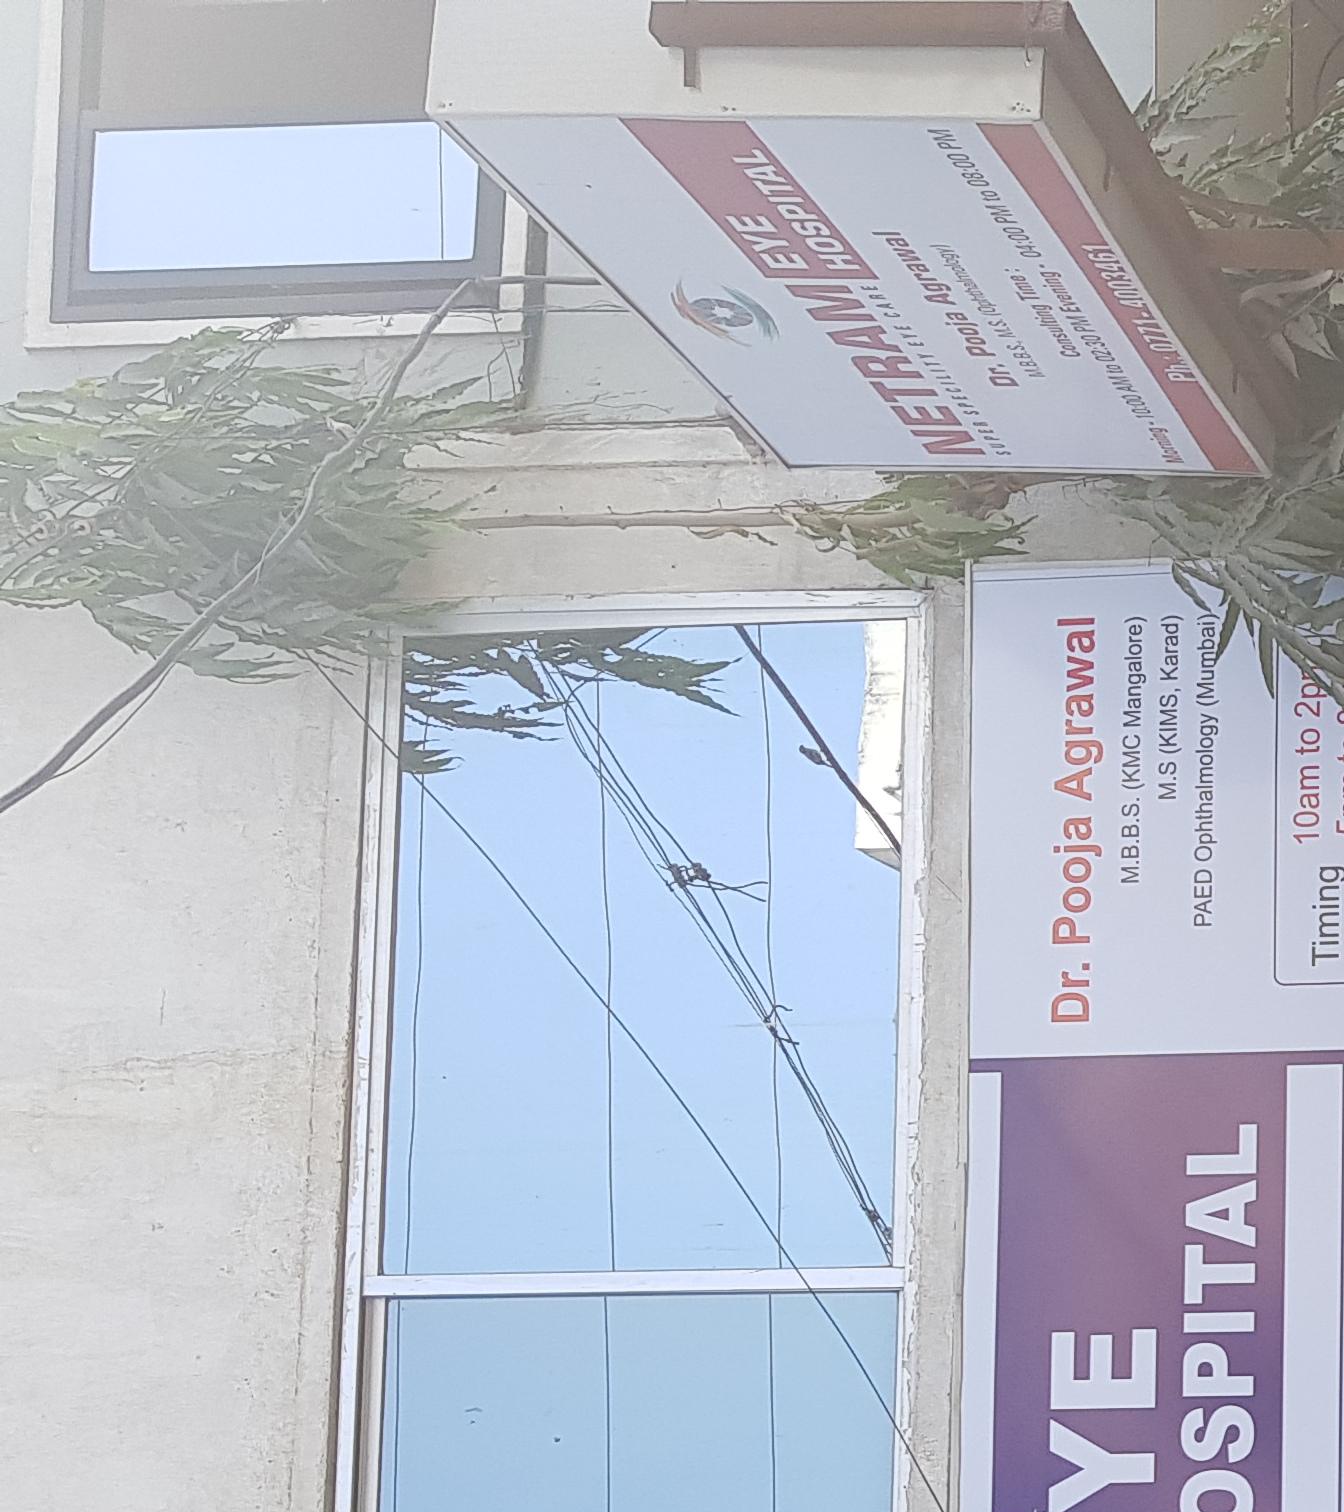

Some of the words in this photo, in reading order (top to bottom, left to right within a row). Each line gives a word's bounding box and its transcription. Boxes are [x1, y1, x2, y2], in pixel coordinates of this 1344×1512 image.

[926, 128, 965, 150] PM
[948, 153, 991, 187] 08:00
[732, 148, 861, 270] HOSPITAL
[980, 190, 1004, 202] to
[986, 204, 1021, 224] PM
[725, 216, 809, 269] EYE
[1003, 226, 1043, 258] 04:00
[872, 231, 957, 305] Agrawal
[929, 243, 1002, 316] (Ophthalmology)
[860, 286, 900, 318] CARE
[1039, 271, 1082, 313] Evening
[893, 325, 924, 347] EYE
[945, 312, 996, 357] Pooja
[1030, 304, 1081, 358] Consulting
[1067, 315, 1098, 333] PM
[784, 284, 986, 455] NETRAM
[1088, 334, 1119, 362] 02:30
[1106, 364, 1123, 374] to
[989, 364, 1020, 387] Dr.
[1107, 375, 1141, 393] AM
[1126, 395, 1155, 419] 10:00
[973, 421, 1012, 456] SUPER
[1148, 427, 1185, 464] Morning
[1160, 615, 1183, 681] Karad)
[1196, 613, 1218, 706] (Mumbai)
[1123, 616, 1147, 727] Mangalore)
[1054, 617, 1104, 801] Agrawal
[1159, 688, 1182, 754] (KIMS,
[1122, 734, 1145, 790] (KMC
[1295, 728, 1320, 755] to
[1158, 762, 1177, 800] M.S
[1195, 714, 1218, 862] Ophthalmology
[1293, 765, 1320, 844] 10am
[1121, 797, 1140, 884] M.B.B.S.
[1051, 817, 1102, 945] Pooja
[1194, 869, 1213, 927] PAED
[1050, 961, 1093, 1024] Dr.
